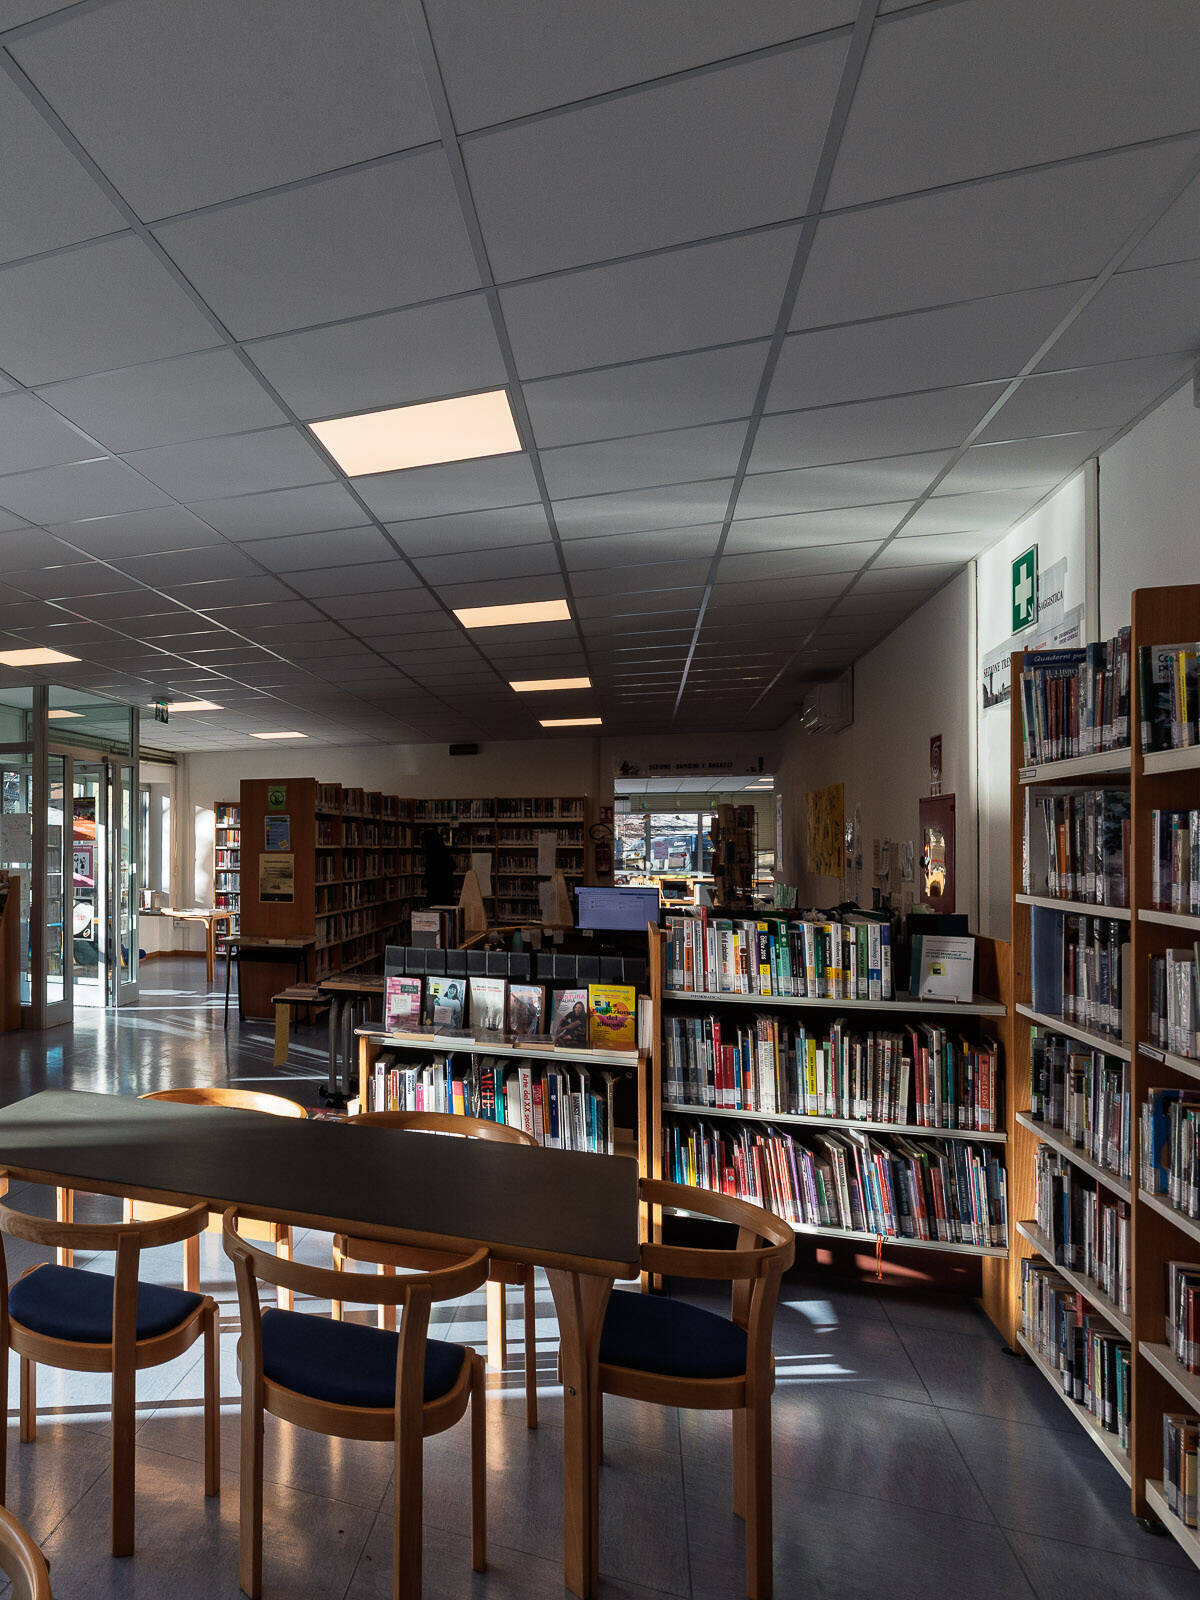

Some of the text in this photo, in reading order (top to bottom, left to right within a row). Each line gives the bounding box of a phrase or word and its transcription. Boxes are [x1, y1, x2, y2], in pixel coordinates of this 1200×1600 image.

[1037, 590, 1064, 612] SAGGISTICA
[983, 653, 1012, 678] SEZIONE TREN
[1033, 653, 1071, 663] Quaderni
[759, 935, 767, 949] Office
[872, 937, 880, 958] Photoshop
[481, 1073, 495, 1109] ARTE
[524, 1102, 531, 1113] XX
